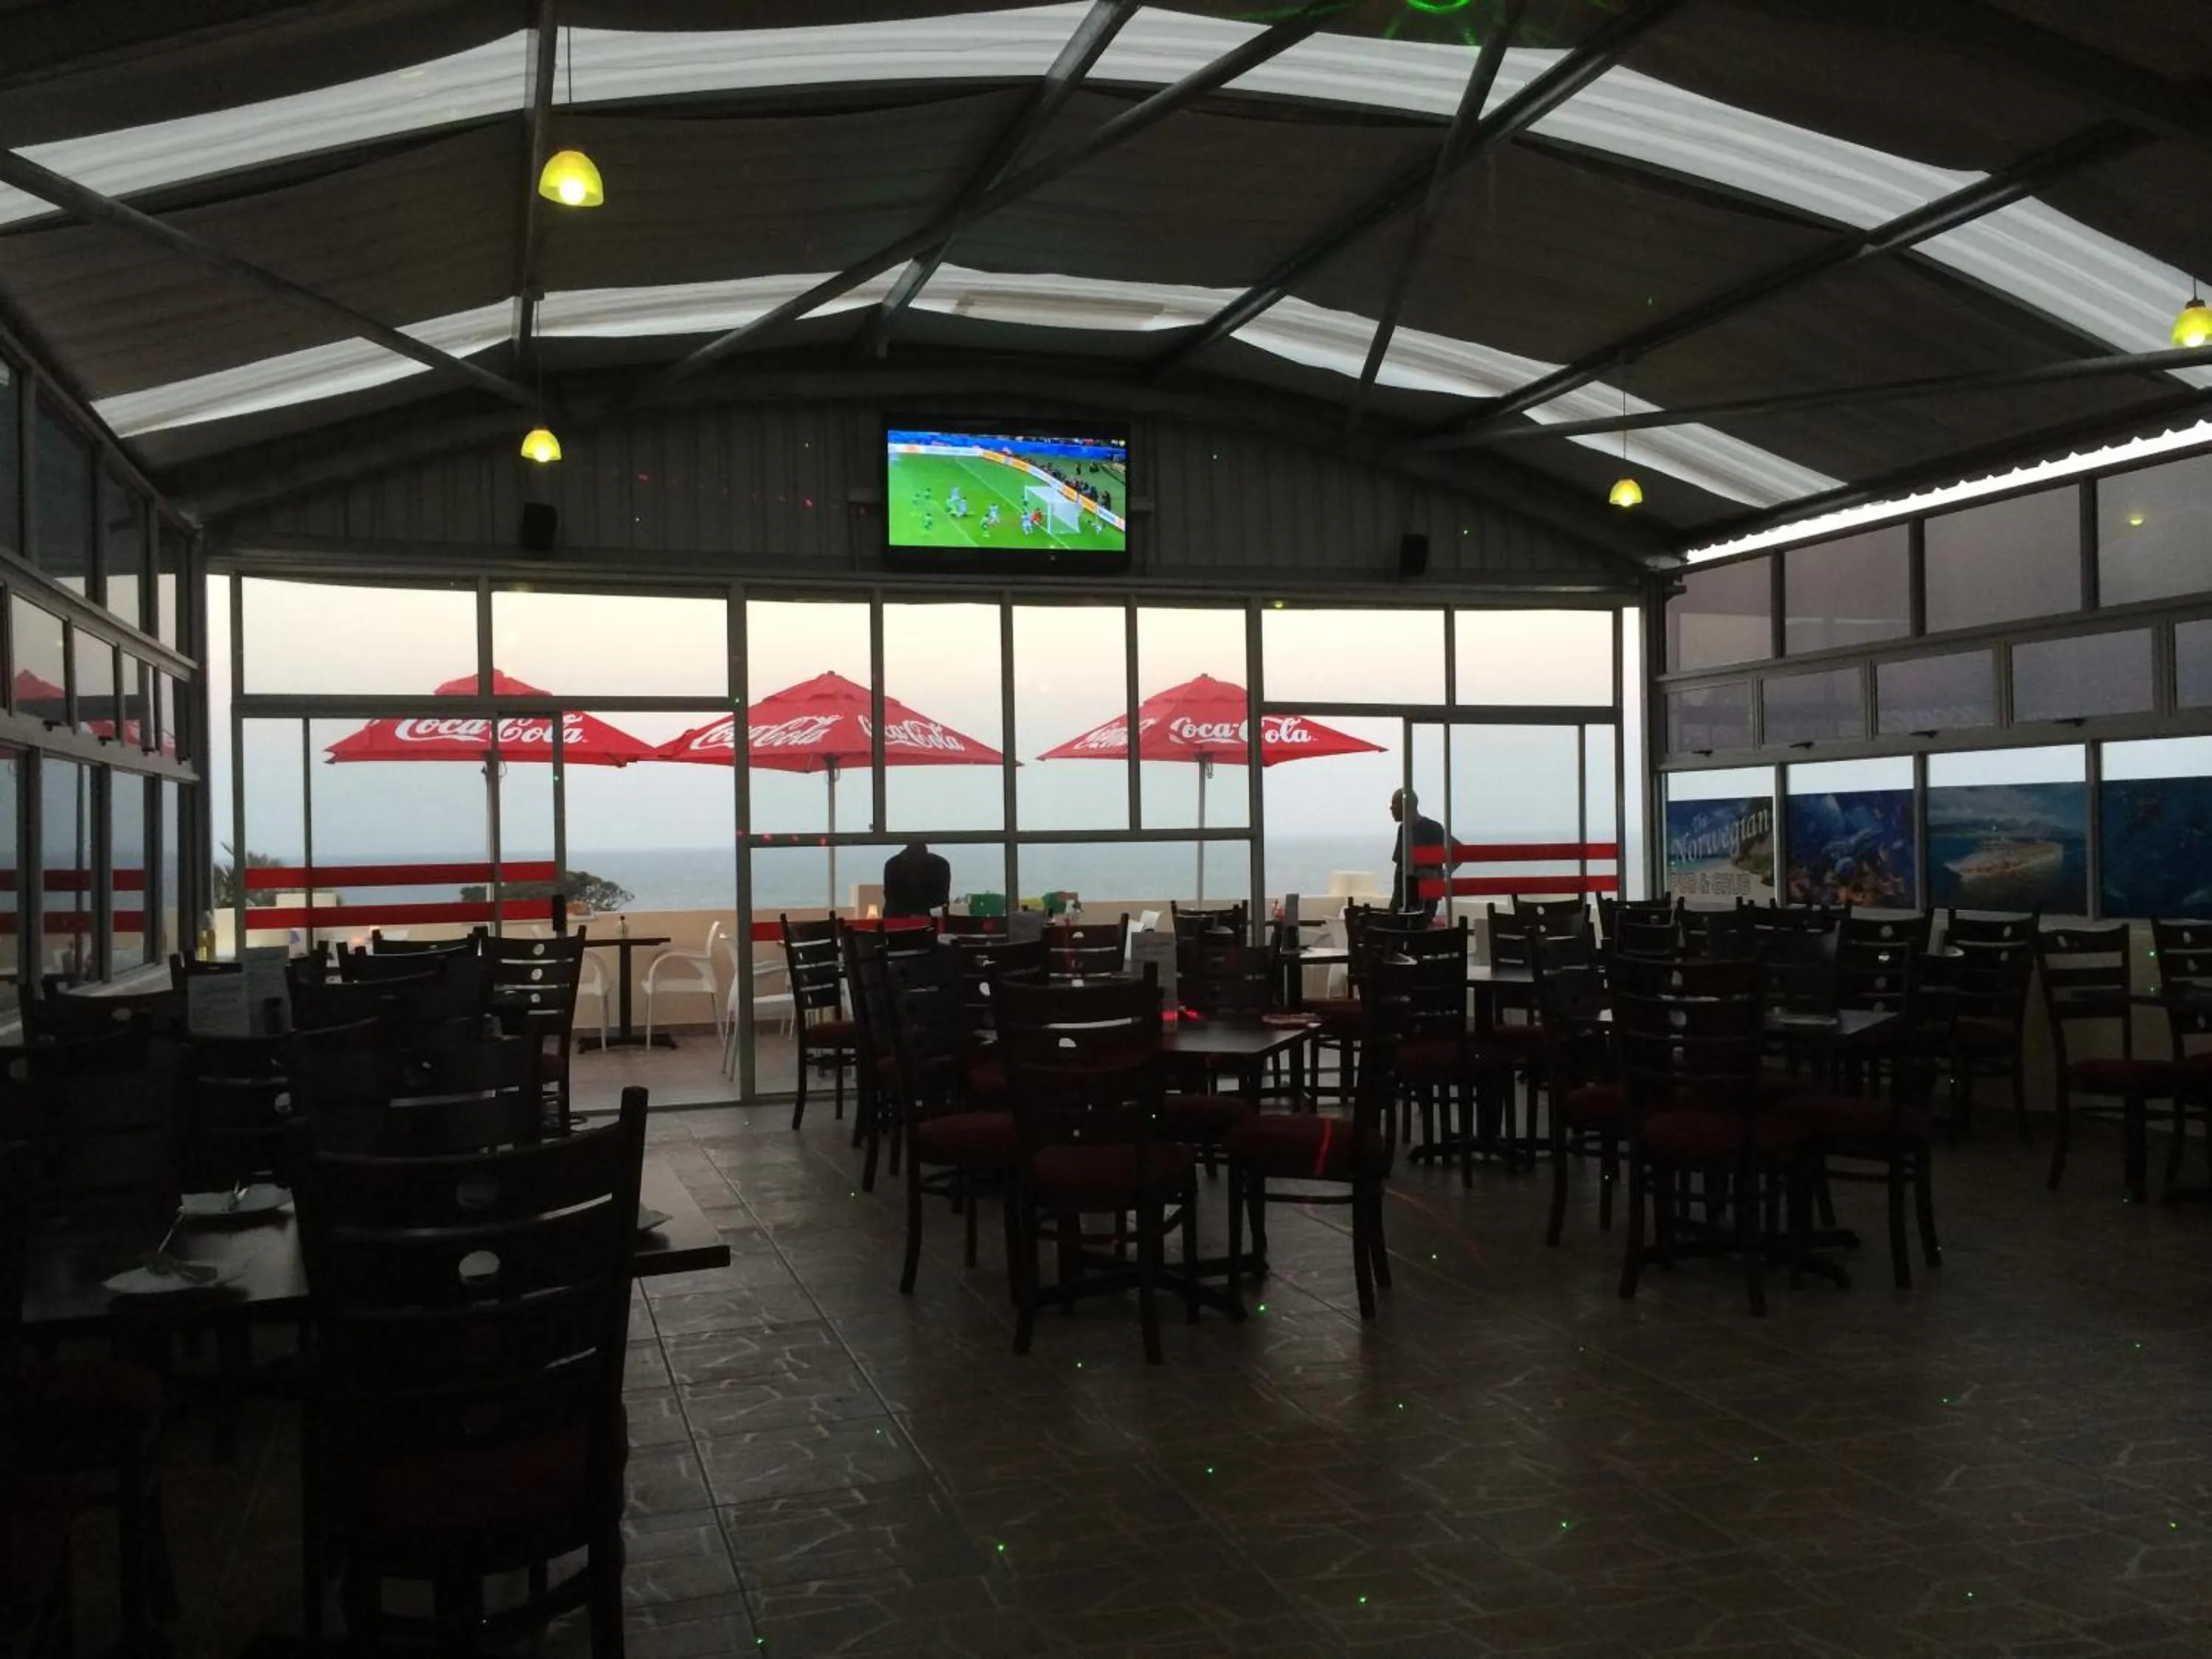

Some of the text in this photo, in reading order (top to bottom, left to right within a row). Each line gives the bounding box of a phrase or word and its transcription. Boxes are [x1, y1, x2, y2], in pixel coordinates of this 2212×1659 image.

[394, 714, 584, 742] CocaCola
[689, 714, 844, 750] Coa-Cola
[858, 714, 964, 751] Cca-Cola
[1671, 808, 1770, 863] Norwegian
